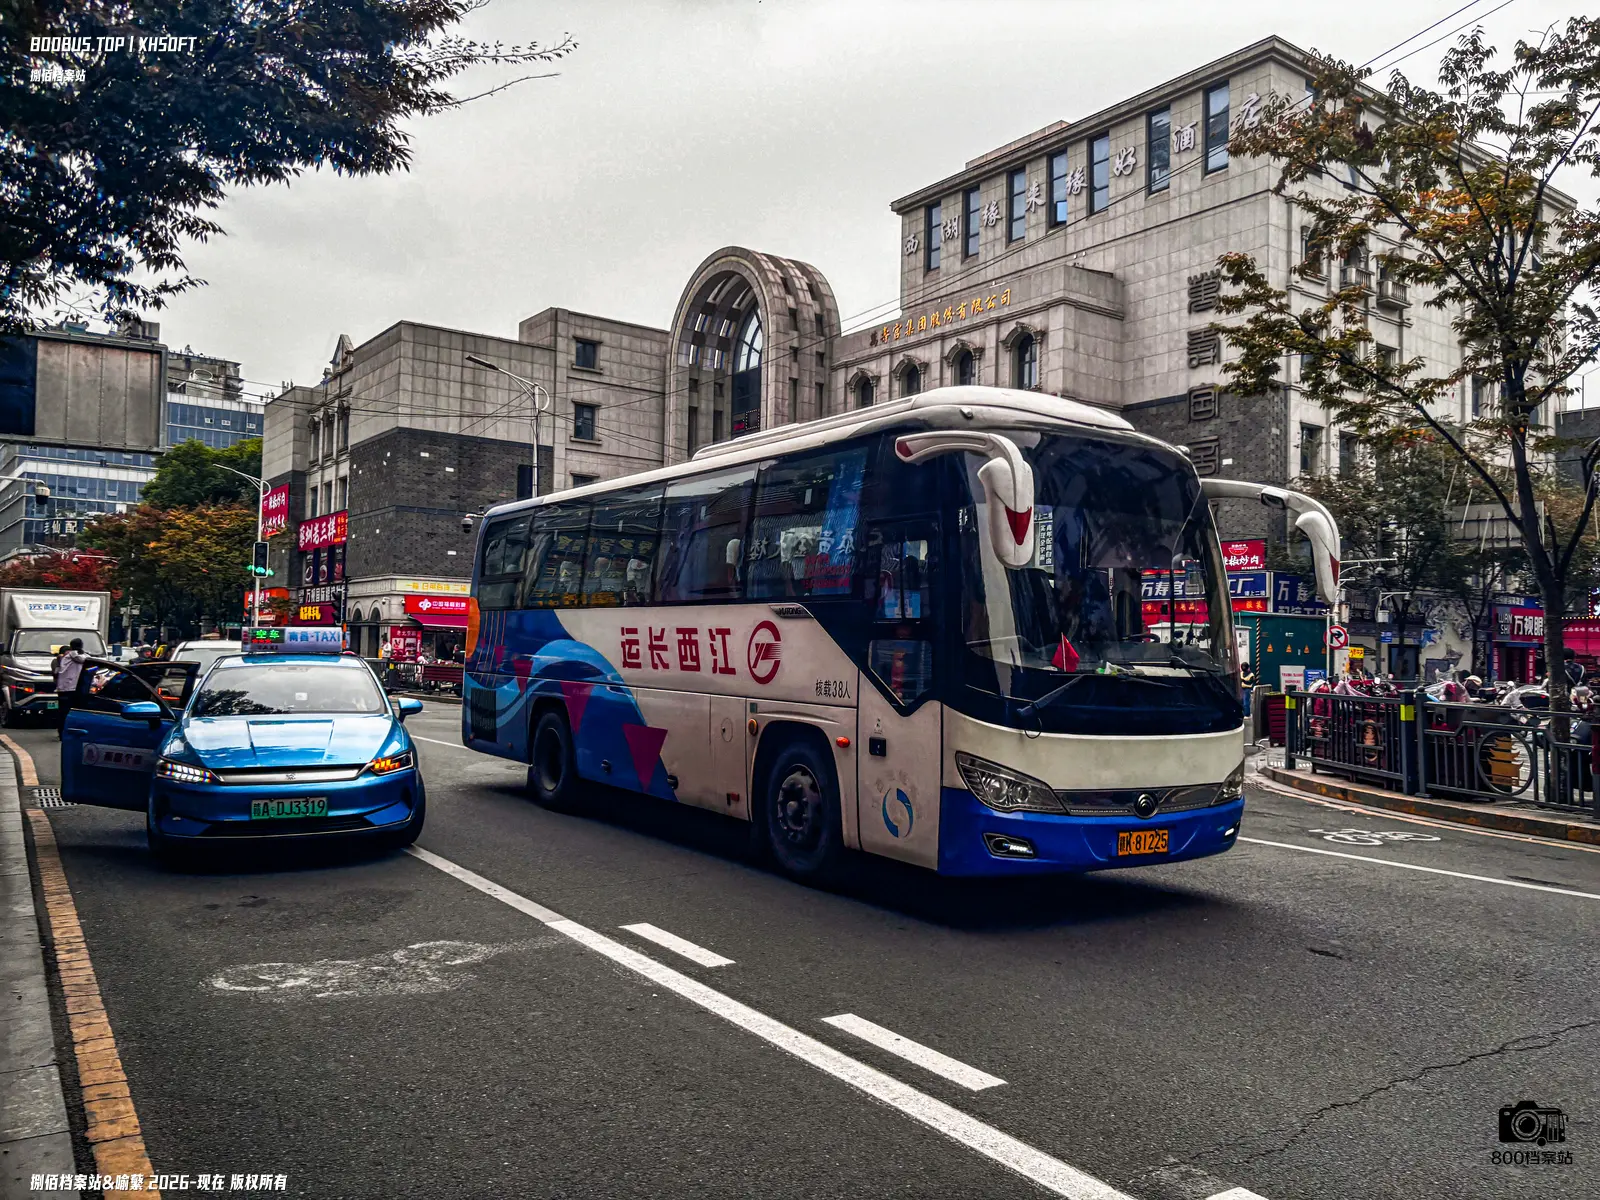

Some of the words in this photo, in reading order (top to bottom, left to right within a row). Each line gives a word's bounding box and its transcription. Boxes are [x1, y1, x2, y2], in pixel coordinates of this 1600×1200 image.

[255, 629, 280, 639] 空车
[815, 678, 851, 699] 核载38人
